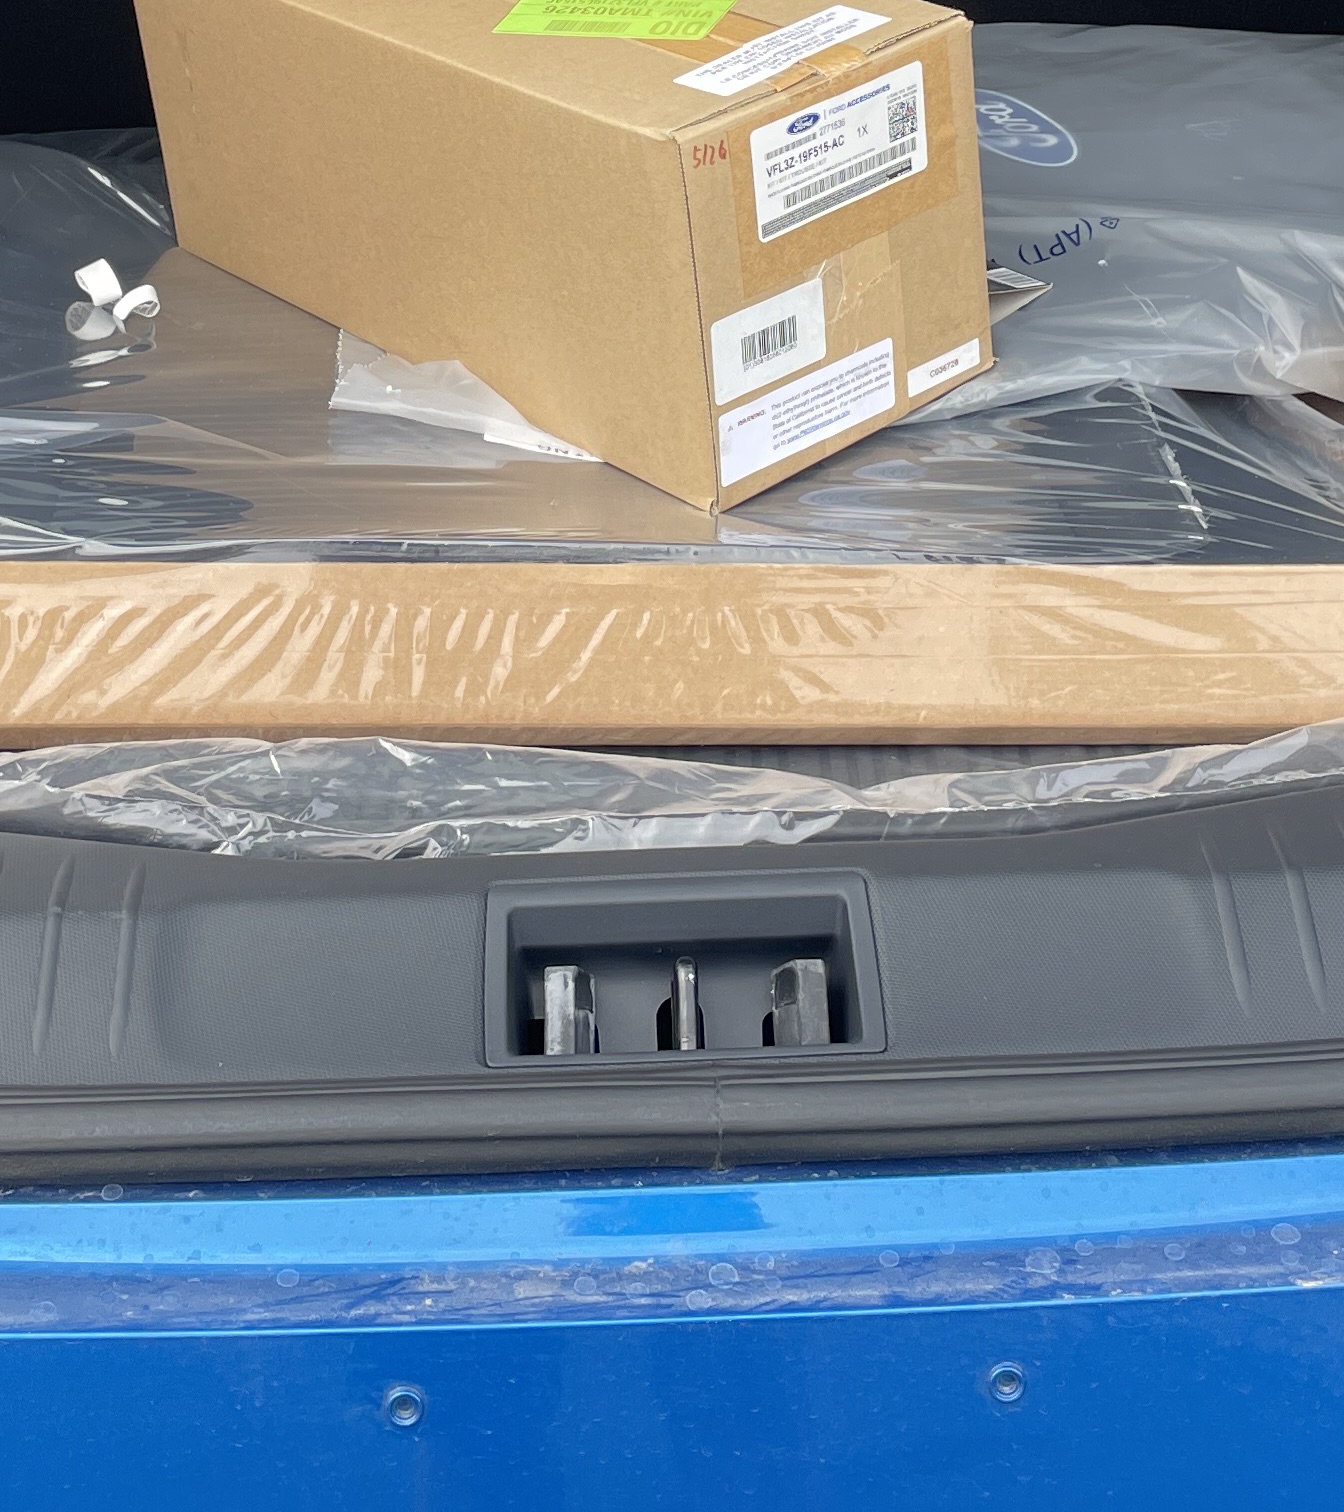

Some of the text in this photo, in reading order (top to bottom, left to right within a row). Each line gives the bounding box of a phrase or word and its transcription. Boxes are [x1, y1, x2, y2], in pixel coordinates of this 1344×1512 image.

[643, 19, 709, 36] DIO
[846, 82, 891, 108] ACCESSORIES
[765, 132, 845, 179] VFL3Z-19F515-AC
[856, 122, 869, 139] 1X
[1018, 218, 1093, 266] (APT)
